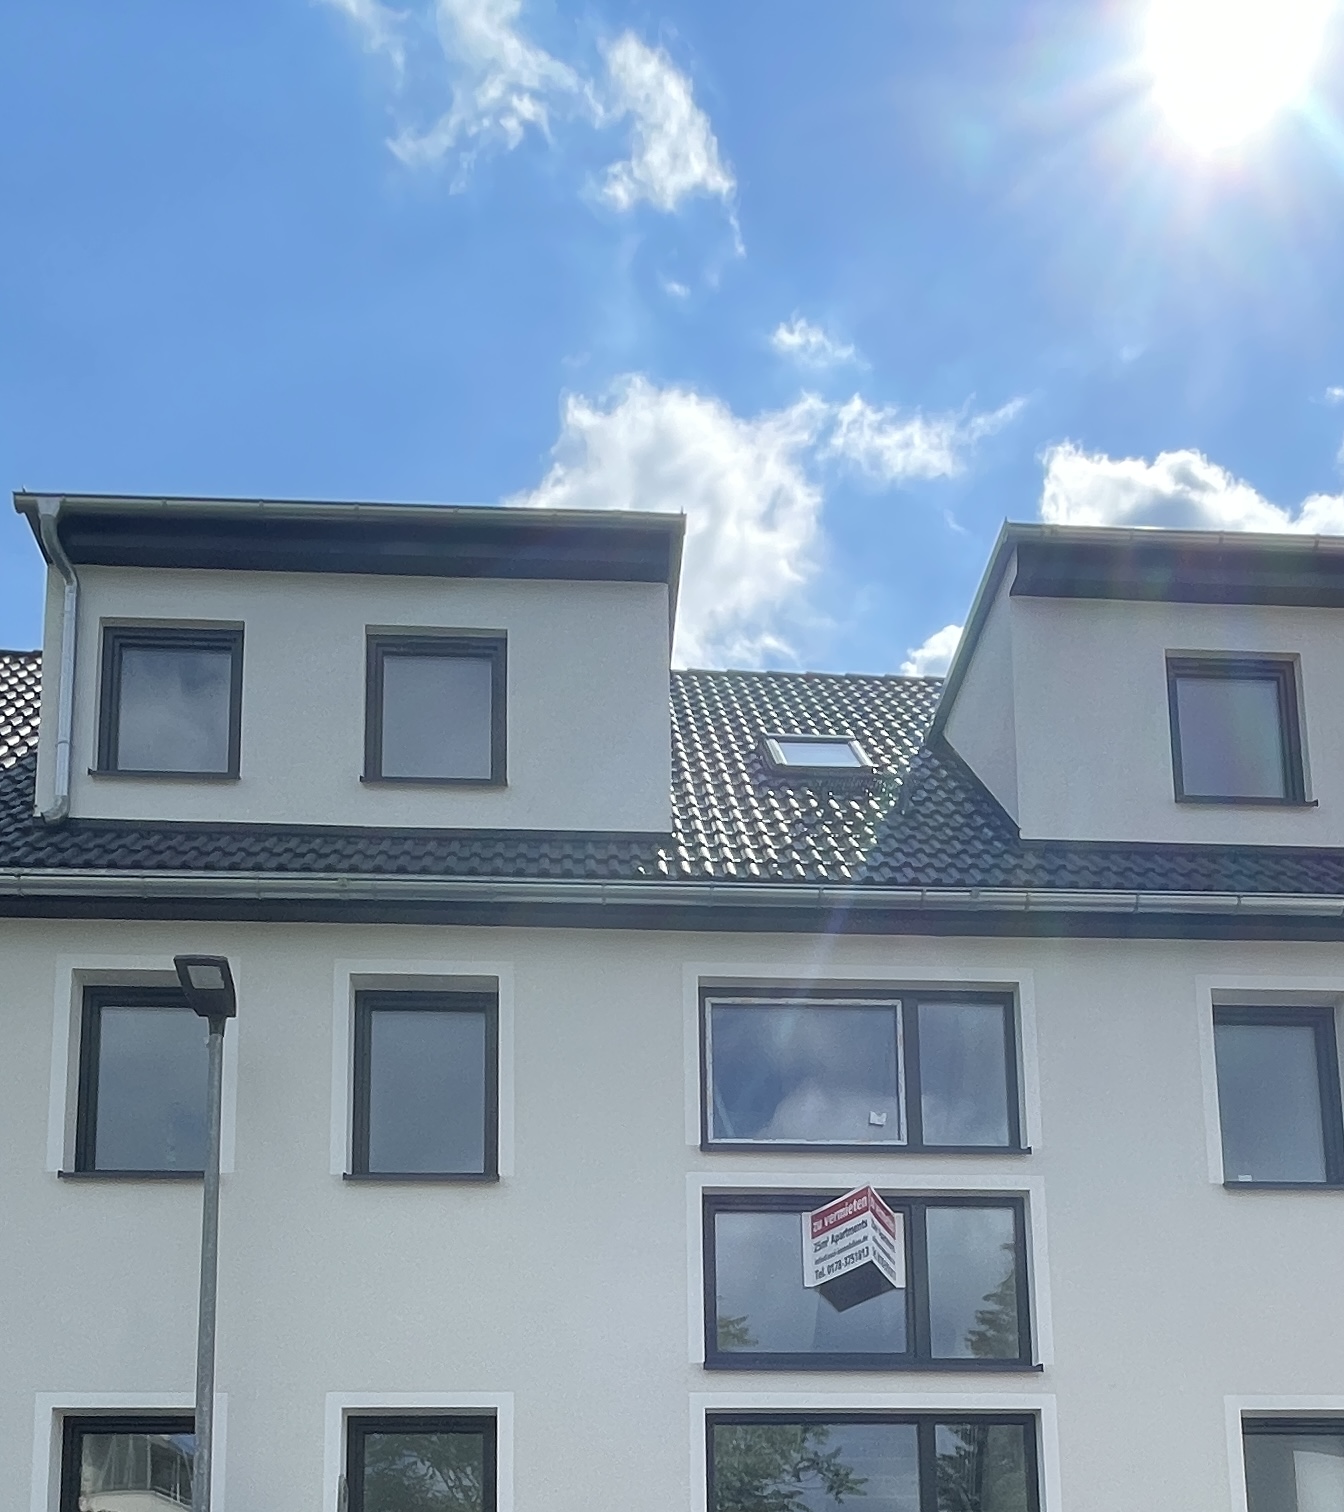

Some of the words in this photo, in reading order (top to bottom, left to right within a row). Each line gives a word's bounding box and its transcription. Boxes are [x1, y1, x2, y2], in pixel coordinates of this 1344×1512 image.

[812, 1220, 822, 1232] zu
[824, 1196, 867, 1226] vermieten
[830, 1219, 868, 1246] Apartments
